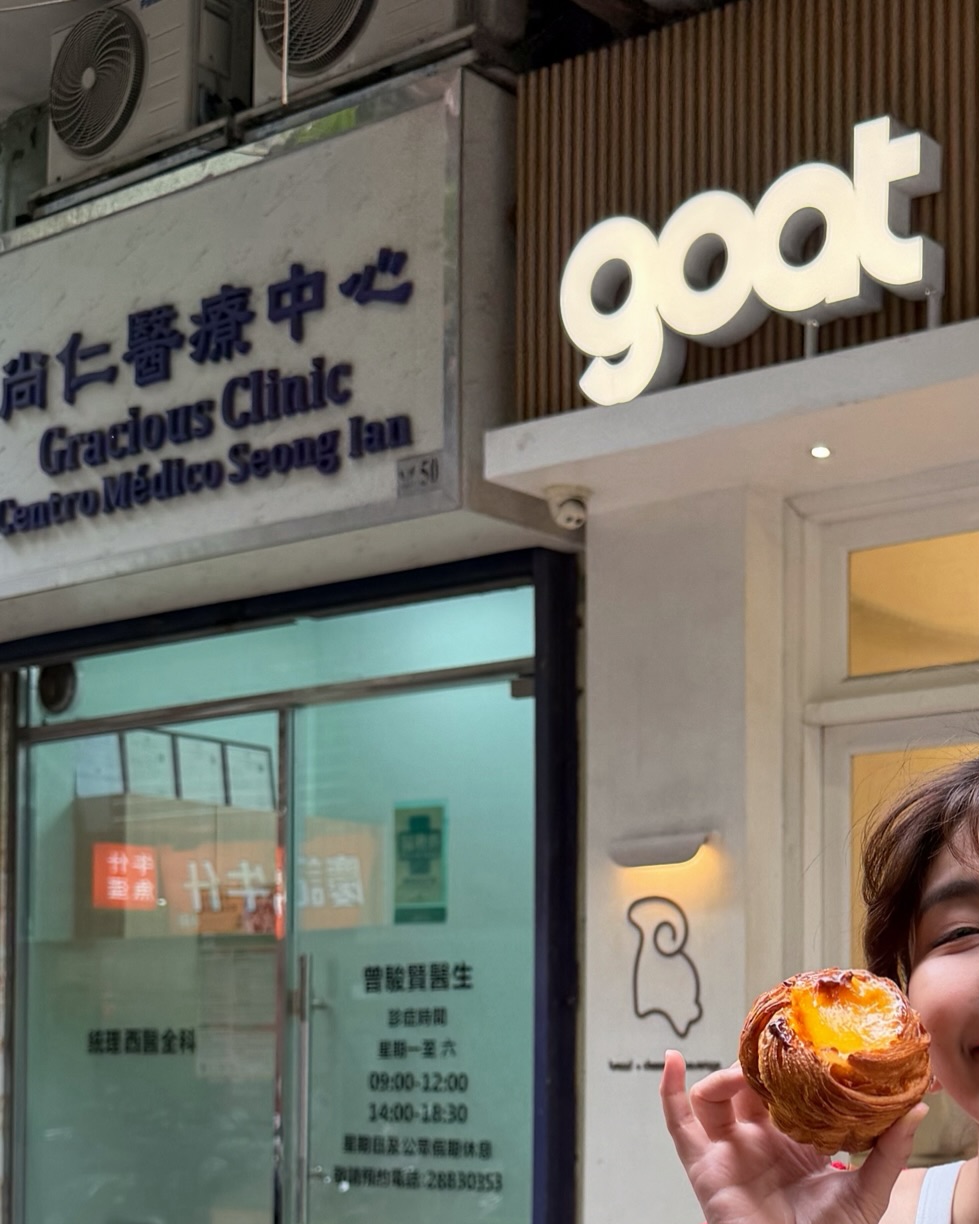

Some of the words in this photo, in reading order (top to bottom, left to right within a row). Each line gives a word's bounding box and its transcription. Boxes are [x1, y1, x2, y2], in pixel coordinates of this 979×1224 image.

[560, 115, 922, 406] goat
[0, 247, 414, 420] 尚仁醫療中心
[38, 398, 217, 476] Gracious
[221, 356, 354, 430] Clinic
[101, 456, 225, 514] Médico
[227, 429, 341, 483] Seong
[348, 413, 413, 459] Ian
[368, 1071, 469, 1093] 09:00-12:00
[378, 1038, 457, 1060] 星期一至六
[368, 1102, 468, 1124] 14:00-18:30
